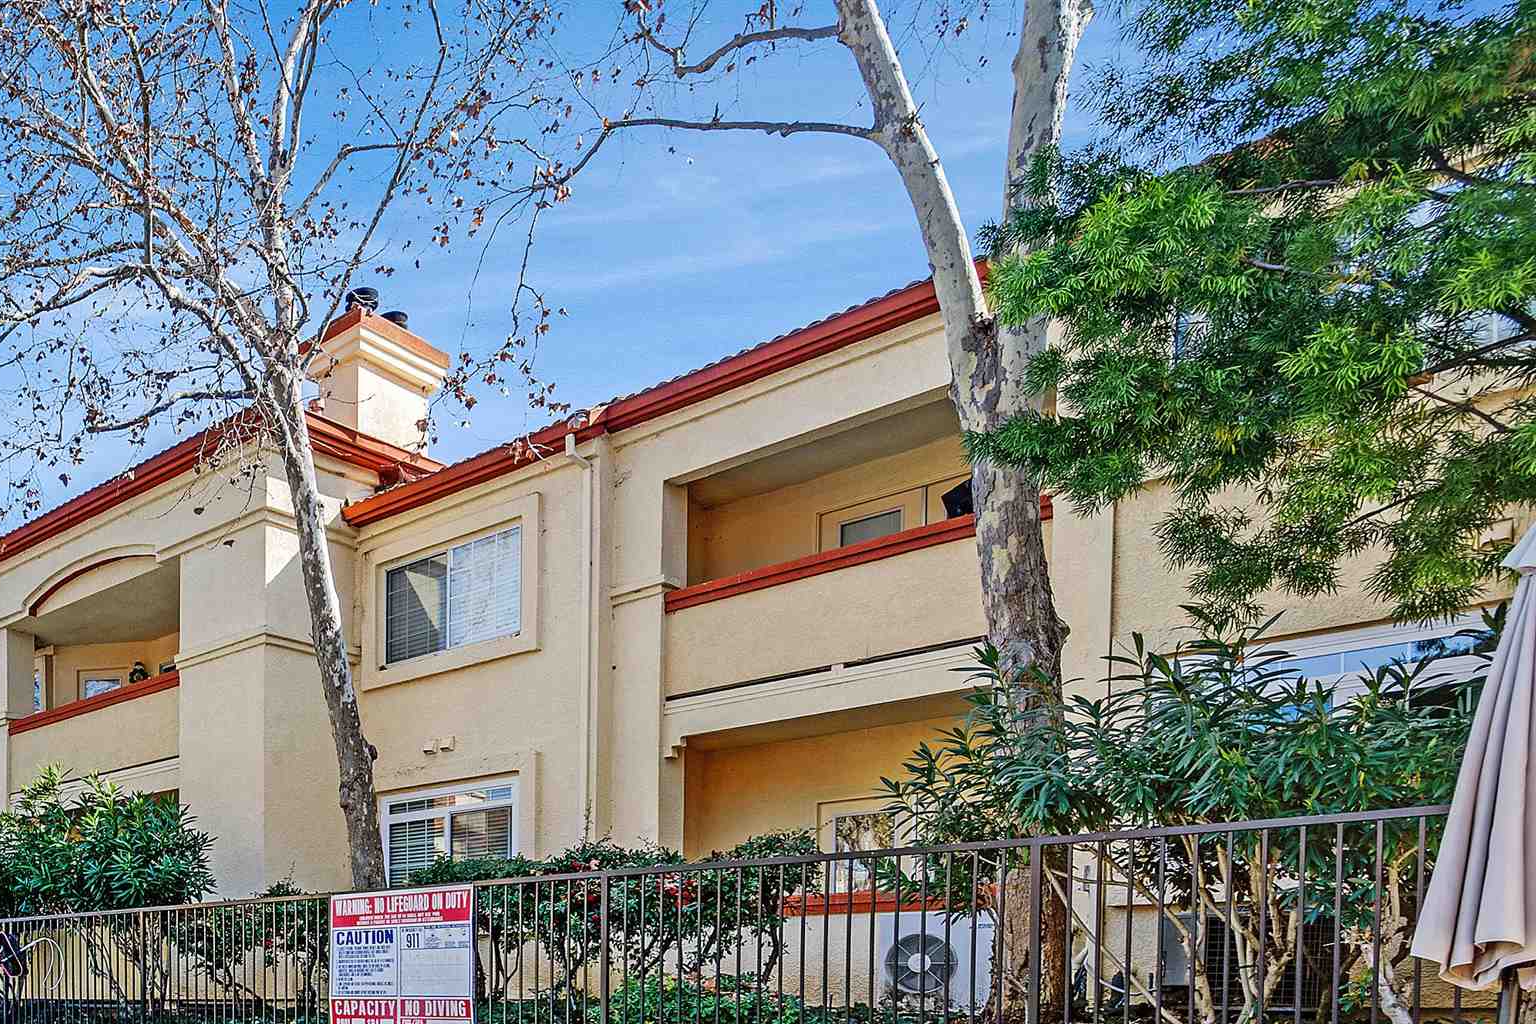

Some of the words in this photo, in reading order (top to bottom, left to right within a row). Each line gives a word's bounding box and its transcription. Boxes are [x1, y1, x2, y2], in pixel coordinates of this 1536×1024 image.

[335, 898, 373, 917] WARNING:
[375, 896, 385, 914] NO
[386, 894, 429, 913] LIFEGUARD
[431, 893, 443, 910] ON
[445, 890, 469, 909] DUTY
[336, 929, 394, 946] CAUTION
[406, 933, 420, 948] 911
[334, 1000, 396, 1017] CAPACITY
[404, 1000, 420, 1017] NO
[424, 1000, 466, 1017] DIVING
